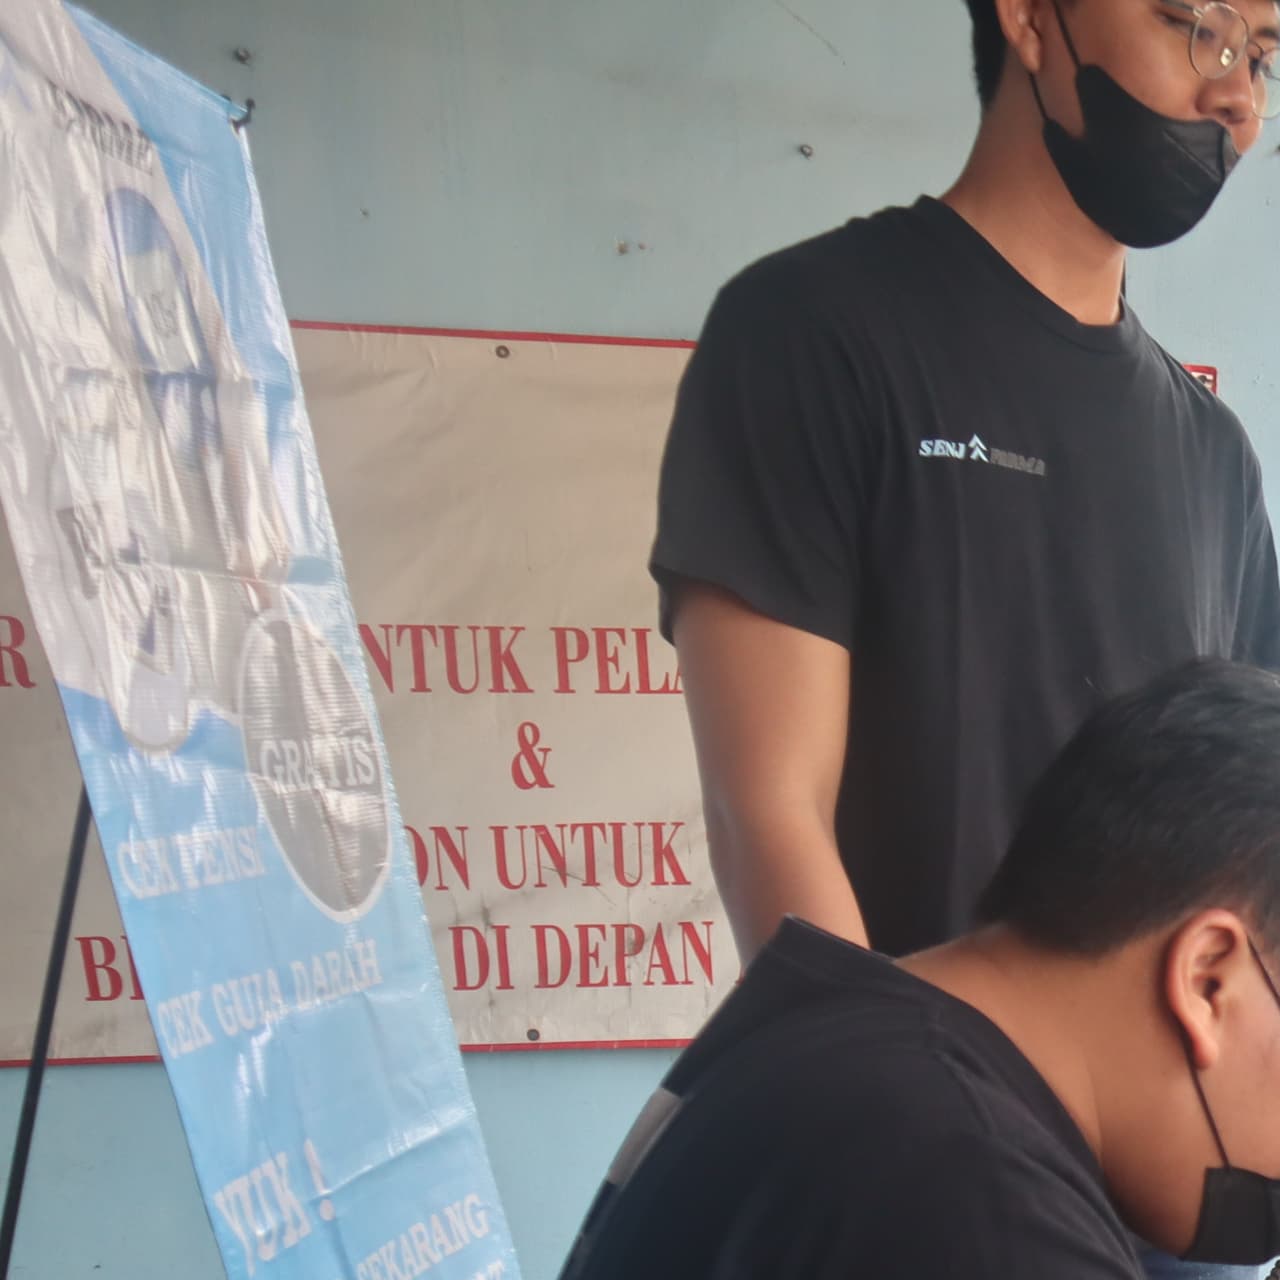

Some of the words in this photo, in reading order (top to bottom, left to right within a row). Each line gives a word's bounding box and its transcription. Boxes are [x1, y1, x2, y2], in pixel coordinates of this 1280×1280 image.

[358, 624, 534, 694] NTUK
[261, 738, 376, 793] GRATIS
[511, 721, 555, 790] &
[117, 836, 178, 899] CEK
[489, 822, 691, 890] UNTUK
[448, 925, 515, 990] DI
[531, 921, 714, 988] DEPAN
[156, 990, 213, 1059] CEK
[211, 968, 284, 1037] GULA
[290, 939, 384, 1011] DARAH
[214, 1152, 312, 1279] YUK
